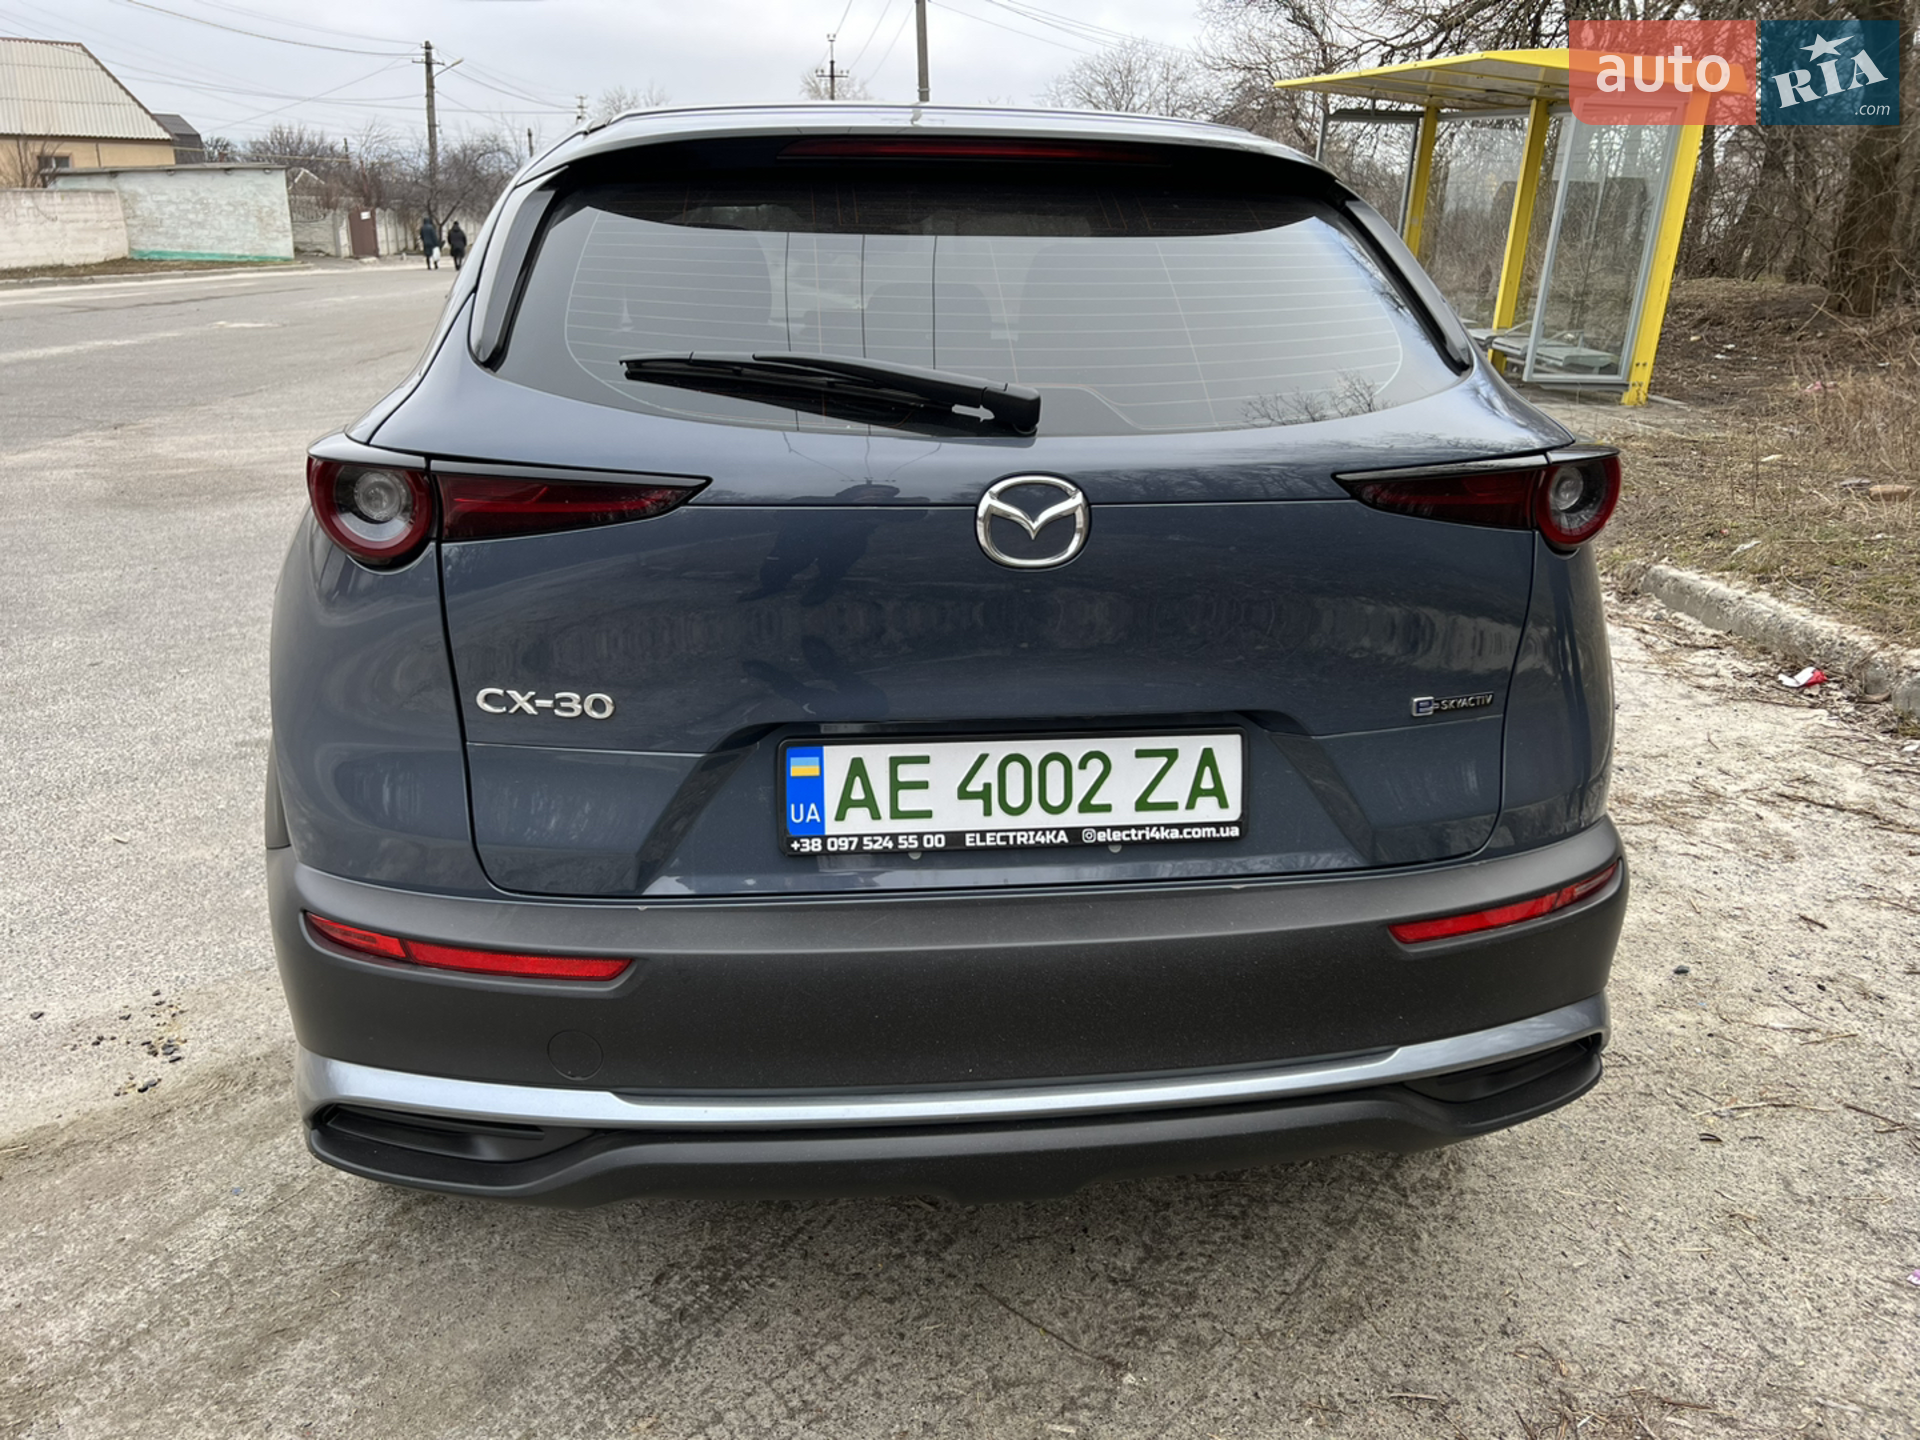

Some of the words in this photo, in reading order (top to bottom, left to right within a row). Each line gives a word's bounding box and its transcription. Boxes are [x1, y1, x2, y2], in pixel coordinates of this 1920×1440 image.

[476, 687, 615, 720] CX-30
[834, 755, 933, 822] AE
[956, 750, 1112, 818] 4002
[1134, 747, 1229, 813] ZA
[789, 803, 821, 824] UA
[790, 837, 822, 852] +38
[826, 836, 858, 851] 097
[862, 835, 894, 850] 524
[897, 834, 919, 849] 55
[922, 833, 946, 848] 00
[965, 829, 1069, 847] ELECTRI4KA
[1096, 825, 1240, 842] electri4ka.com.ua
